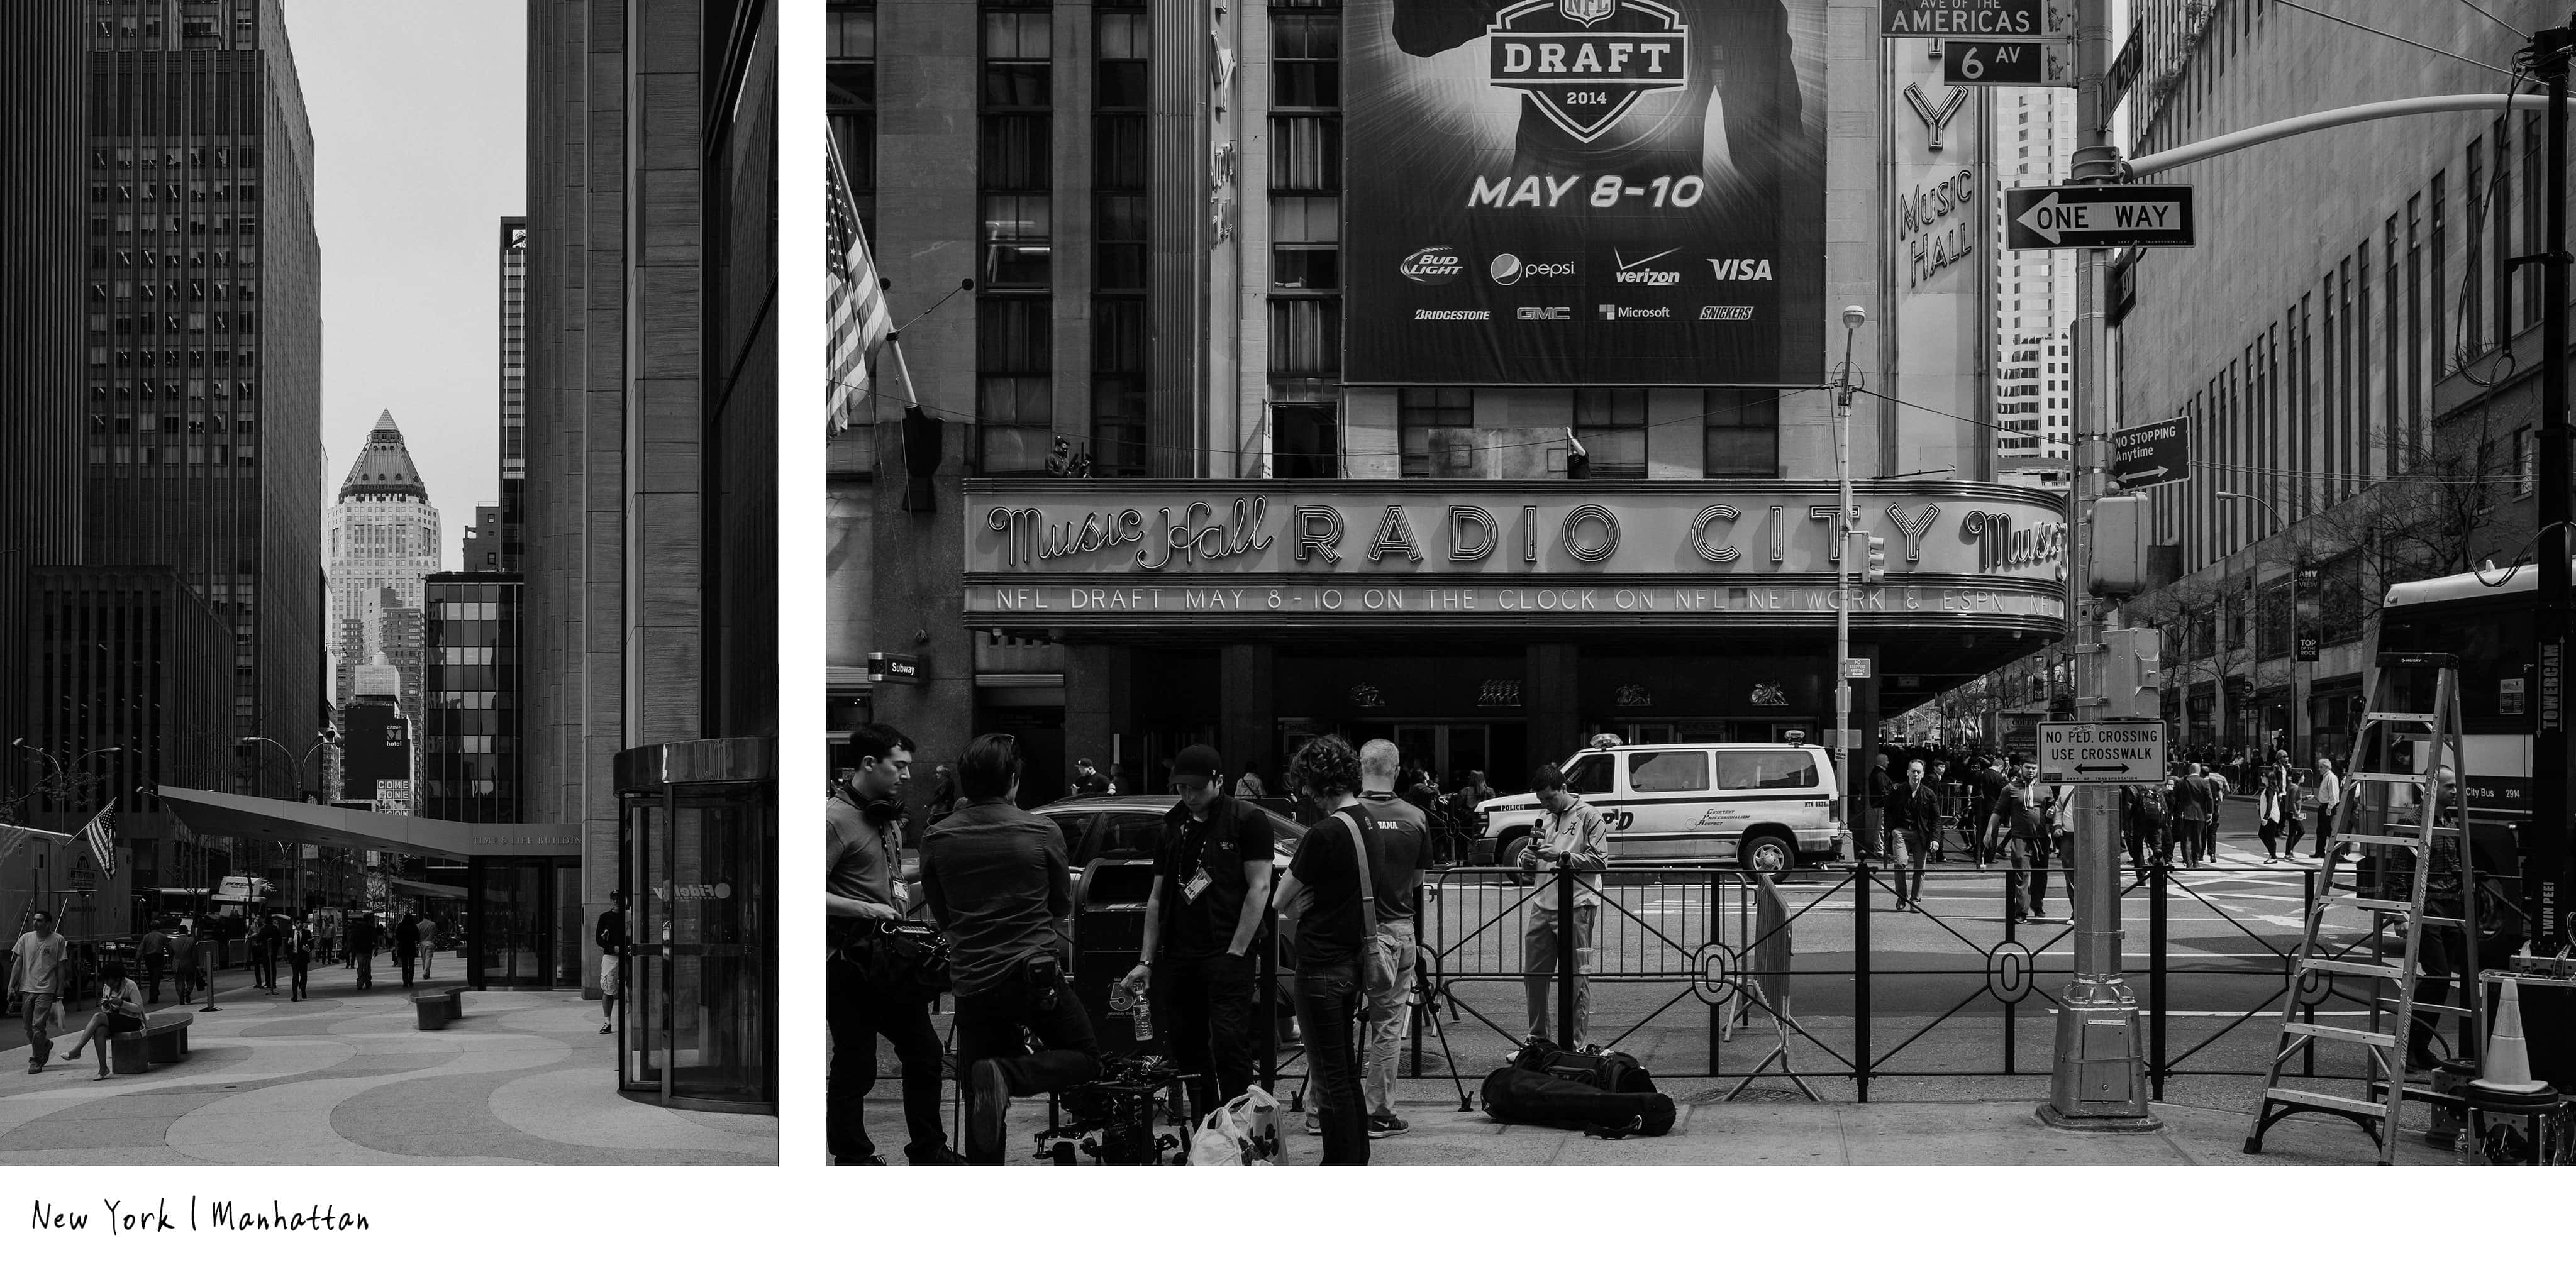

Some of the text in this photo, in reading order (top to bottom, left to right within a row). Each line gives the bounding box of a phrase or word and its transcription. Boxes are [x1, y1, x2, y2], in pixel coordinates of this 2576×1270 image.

[1891, 10, 2030, 32] AMERICAS
[1504, 43, 1670, 72] DRAFT
[1962, 47, 2021, 79] 6 AV
[2120, 41, 2133, 91] 50
[1567, 92, 1607, 104] 2014
[1468, 175, 1704, 207] MAY 8-10
[1900, 169, 1972, 241] MUSIC
[2037, 205, 2169, 229] ONE WAY
[1419, 254, 1458, 265] BUD
[1911, 221, 1972, 288] HALL
[1409, 265, 1463, 275] LIGHT
[1525, 261, 1574, 278] pepsi
[1616, 268, 1680, 285] verizon
[1706, 258, 1772, 280] VISA
[1414, 309, 1491, 320] BRIDGESTONE
[1517, 307, 1570, 320] GMC
[1618, 306, 1670, 318] Microsoft
[1701, 307, 1753, 319] SNICKERS
[2116, 425, 2176, 448] NO STOPPING
[2116, 446, 2154, 462] Anytime
[987, 494, 1275, 569] Music Hall
[1295, 502, 1941, 565] RADIO CITY
[997, 589, 1048, 609] NFL
[1071, 589, 1163, 609] DRAFT
[1186, 588, 1244, 609] MAY
[1363, 589, 1403, 610] ON
[1426, 589, 1475, 610] THE
[1498, 589, 1595, 610] CLOCK
[1615, 589, 1654, 610] ON
[1675, 589, 1726, 610] NFL
[1750, 588, 1882, 610] NETWORK
[1906, 589, 1920, 610] &
[1943, 590, 2004, 612] ESPN
[2031, 594, 2055, 616] NFL
[892, 661, 915, 676] Subway
[2543, 644, 2560, 729] TOWERCAM
[2046, 732, 2062, 743] NO
[2068, 731, 2094, 743] PED.
[2099, 730, 2158, 743] CROSSING
[2051, 748, 2152, 760] USE CROSSWALK
[378, 781, 408, 789] COME
[2465, 787, 2521, 798] City Bus 2914
[386, 790, 408, 798] ONE
[472, 836, 497, 845] TIME
[511, 836, 533, 845] LIFE
[538, 836, 582, 845] BUILDIN
